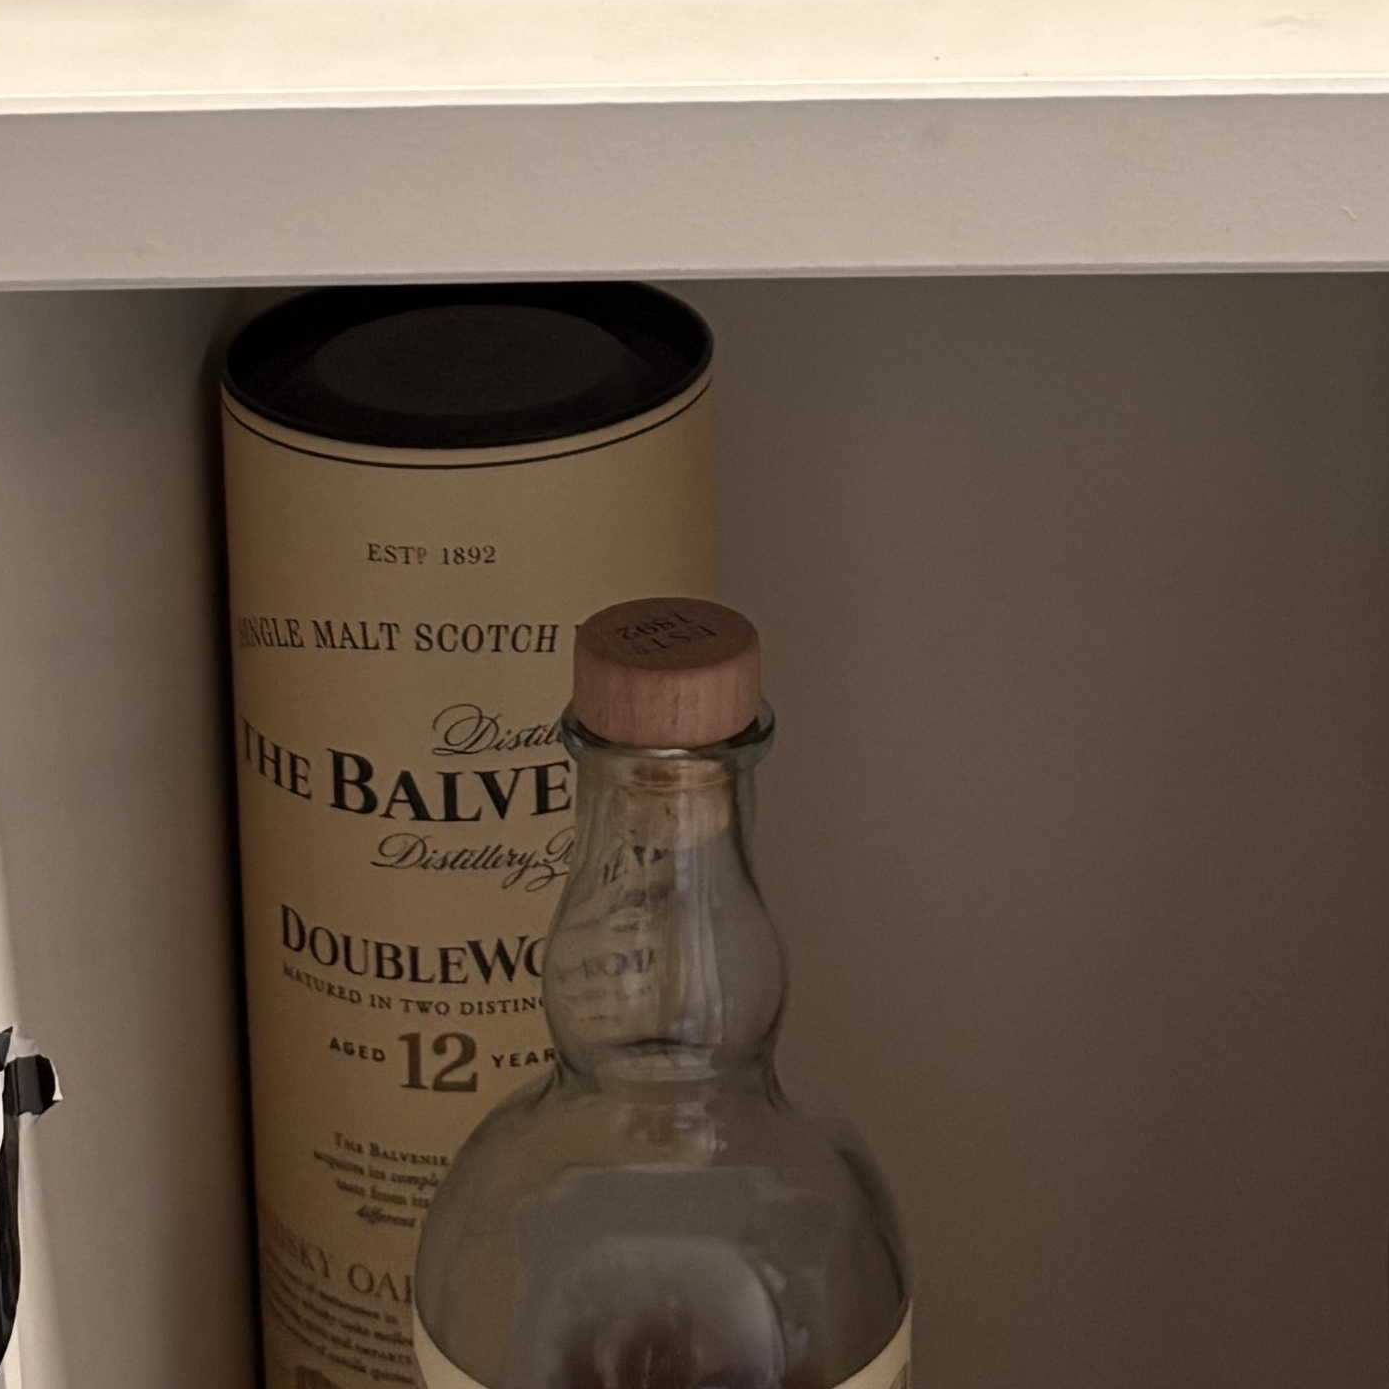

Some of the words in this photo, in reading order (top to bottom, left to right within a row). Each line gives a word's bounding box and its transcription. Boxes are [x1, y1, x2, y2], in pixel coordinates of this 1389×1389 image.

[441, 544, 497, 566] 1892
[314, 621, 400, 652] MALT
[414, 623, 558, 654] SCOTCH
[241, 716, 312, 801] THE
[282, 961, 364, 1008] MATURED
[369, 992, 393, 1010] IN
[399, 999, 451, 1018] TWO
[328, 1036, 388, 1064] AGED
[397, 1031, 479, 1094] 12
